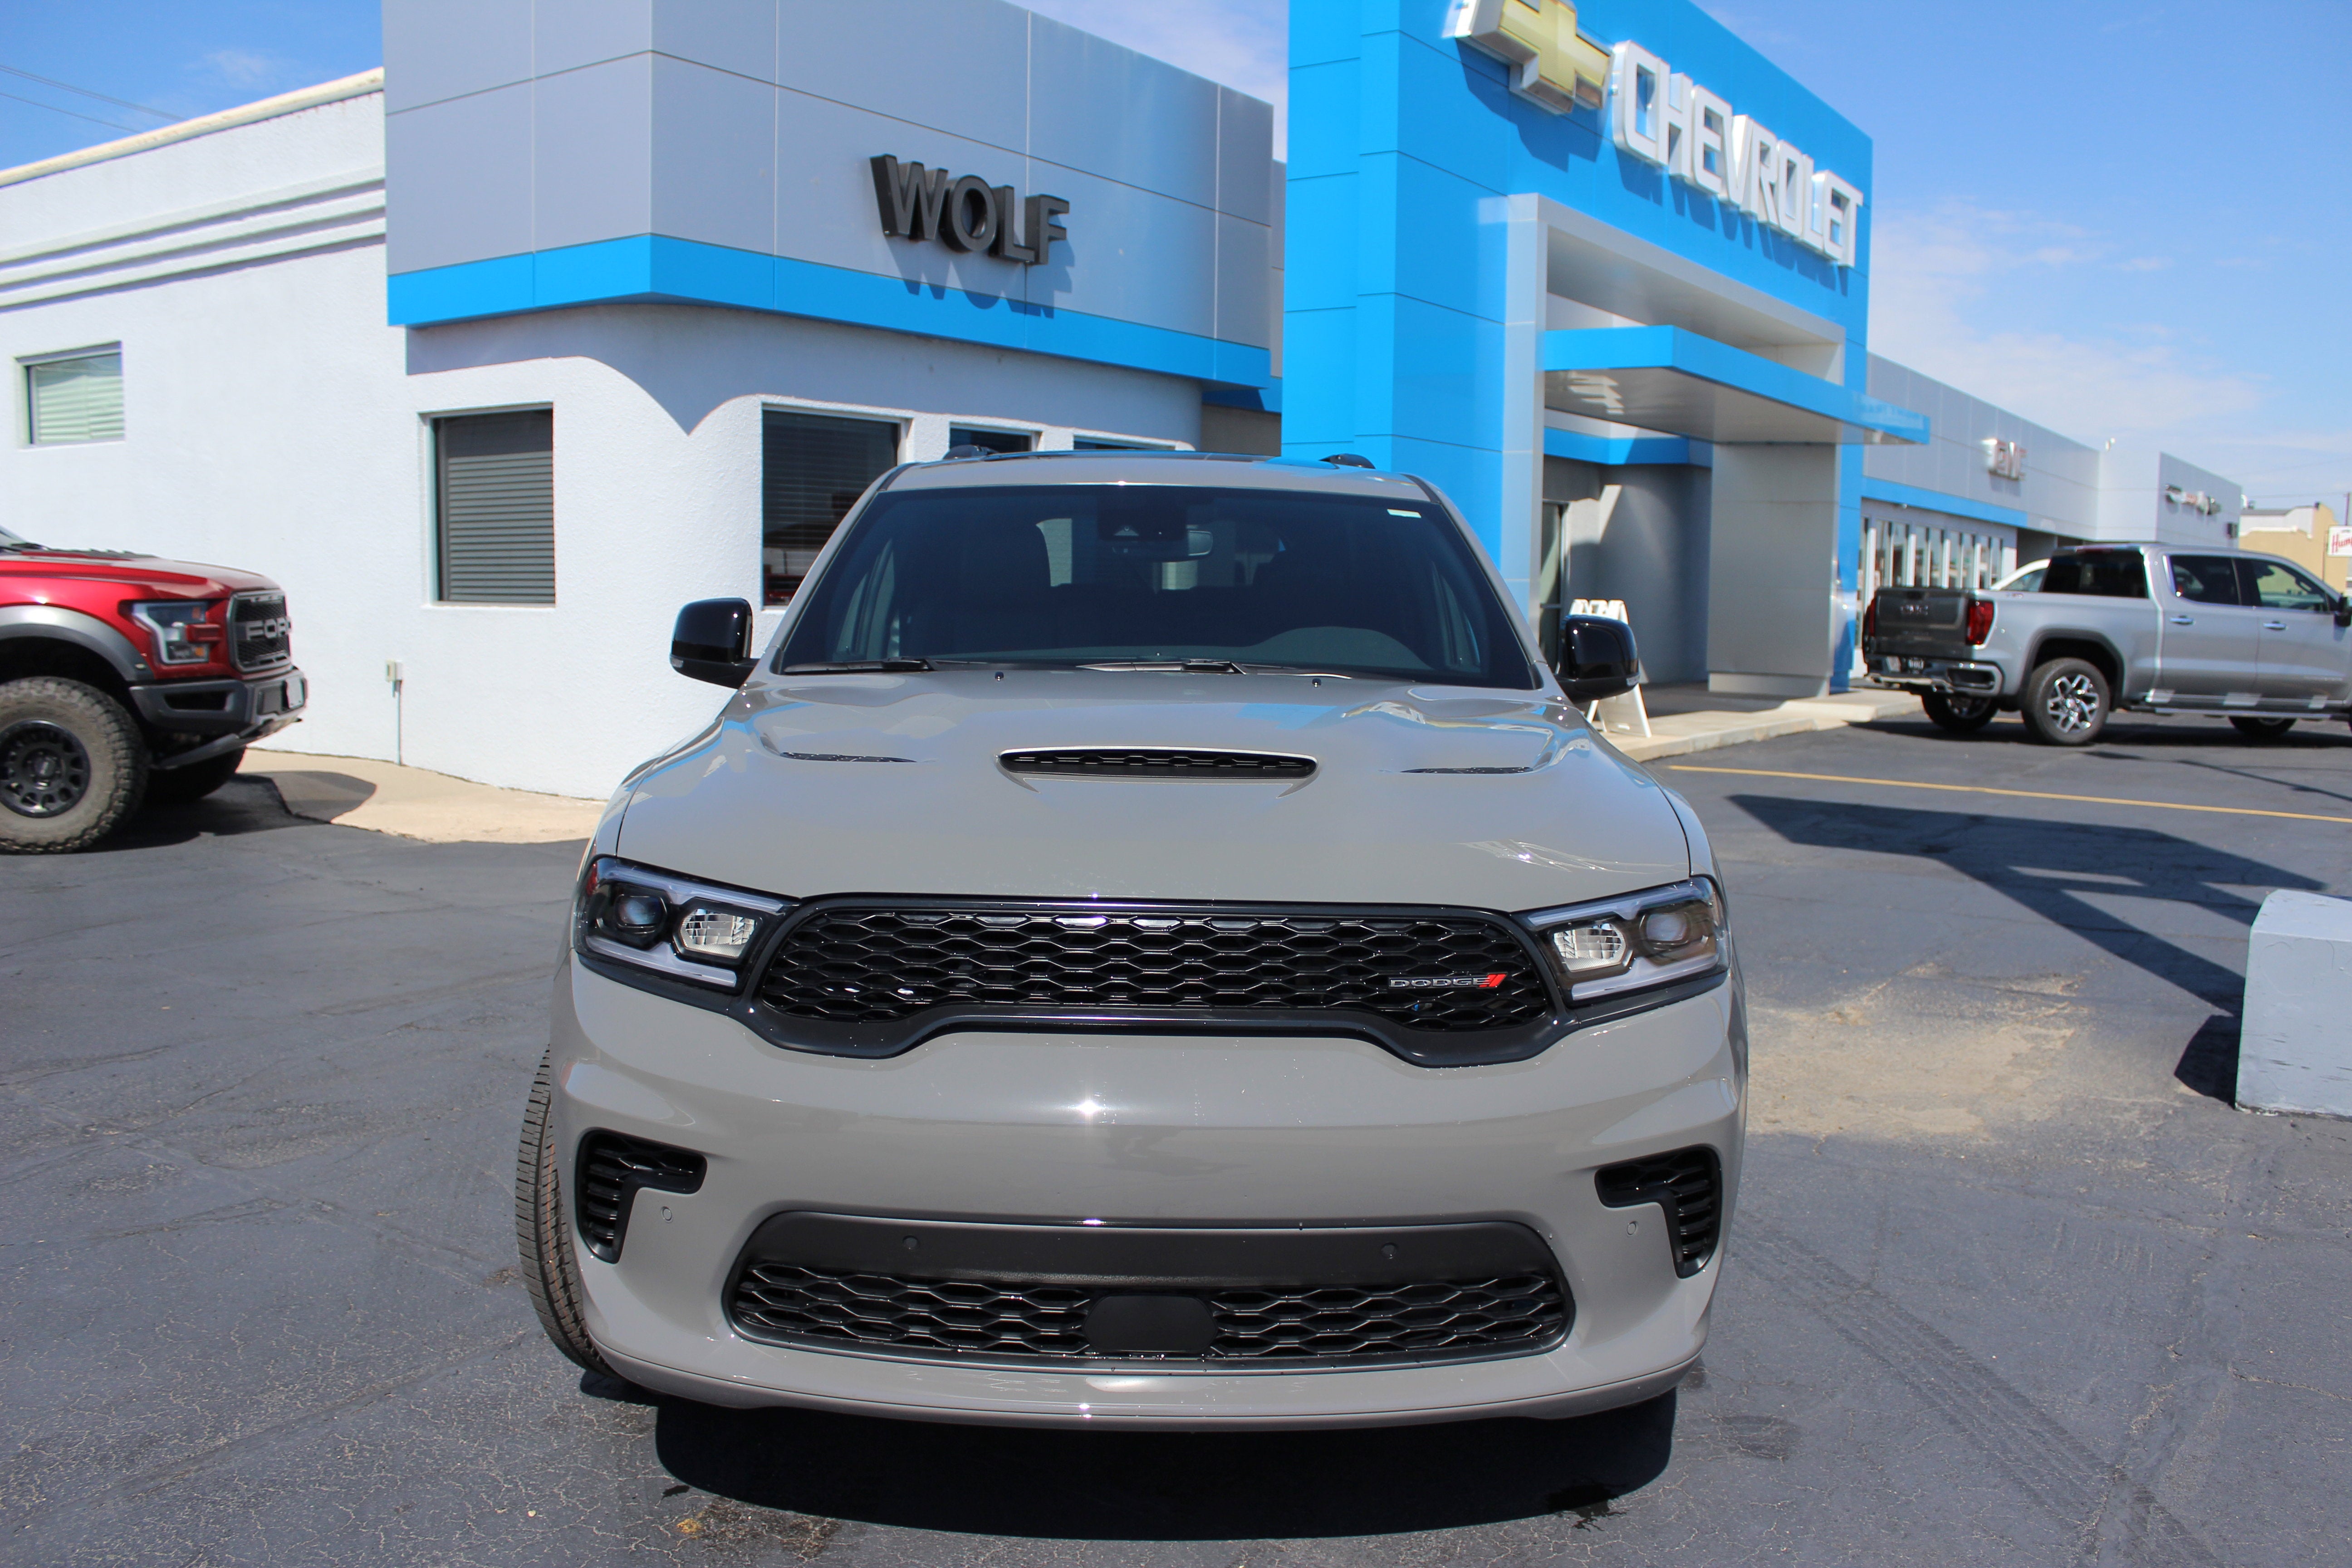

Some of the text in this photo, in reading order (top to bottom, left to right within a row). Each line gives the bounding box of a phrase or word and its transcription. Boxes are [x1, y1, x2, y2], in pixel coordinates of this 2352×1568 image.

[870, 153, 1069, 266] WOLF
[1612, 39, 1863, 268] CHEVROLET
[1390, 977, 1490, 987] DODGE
